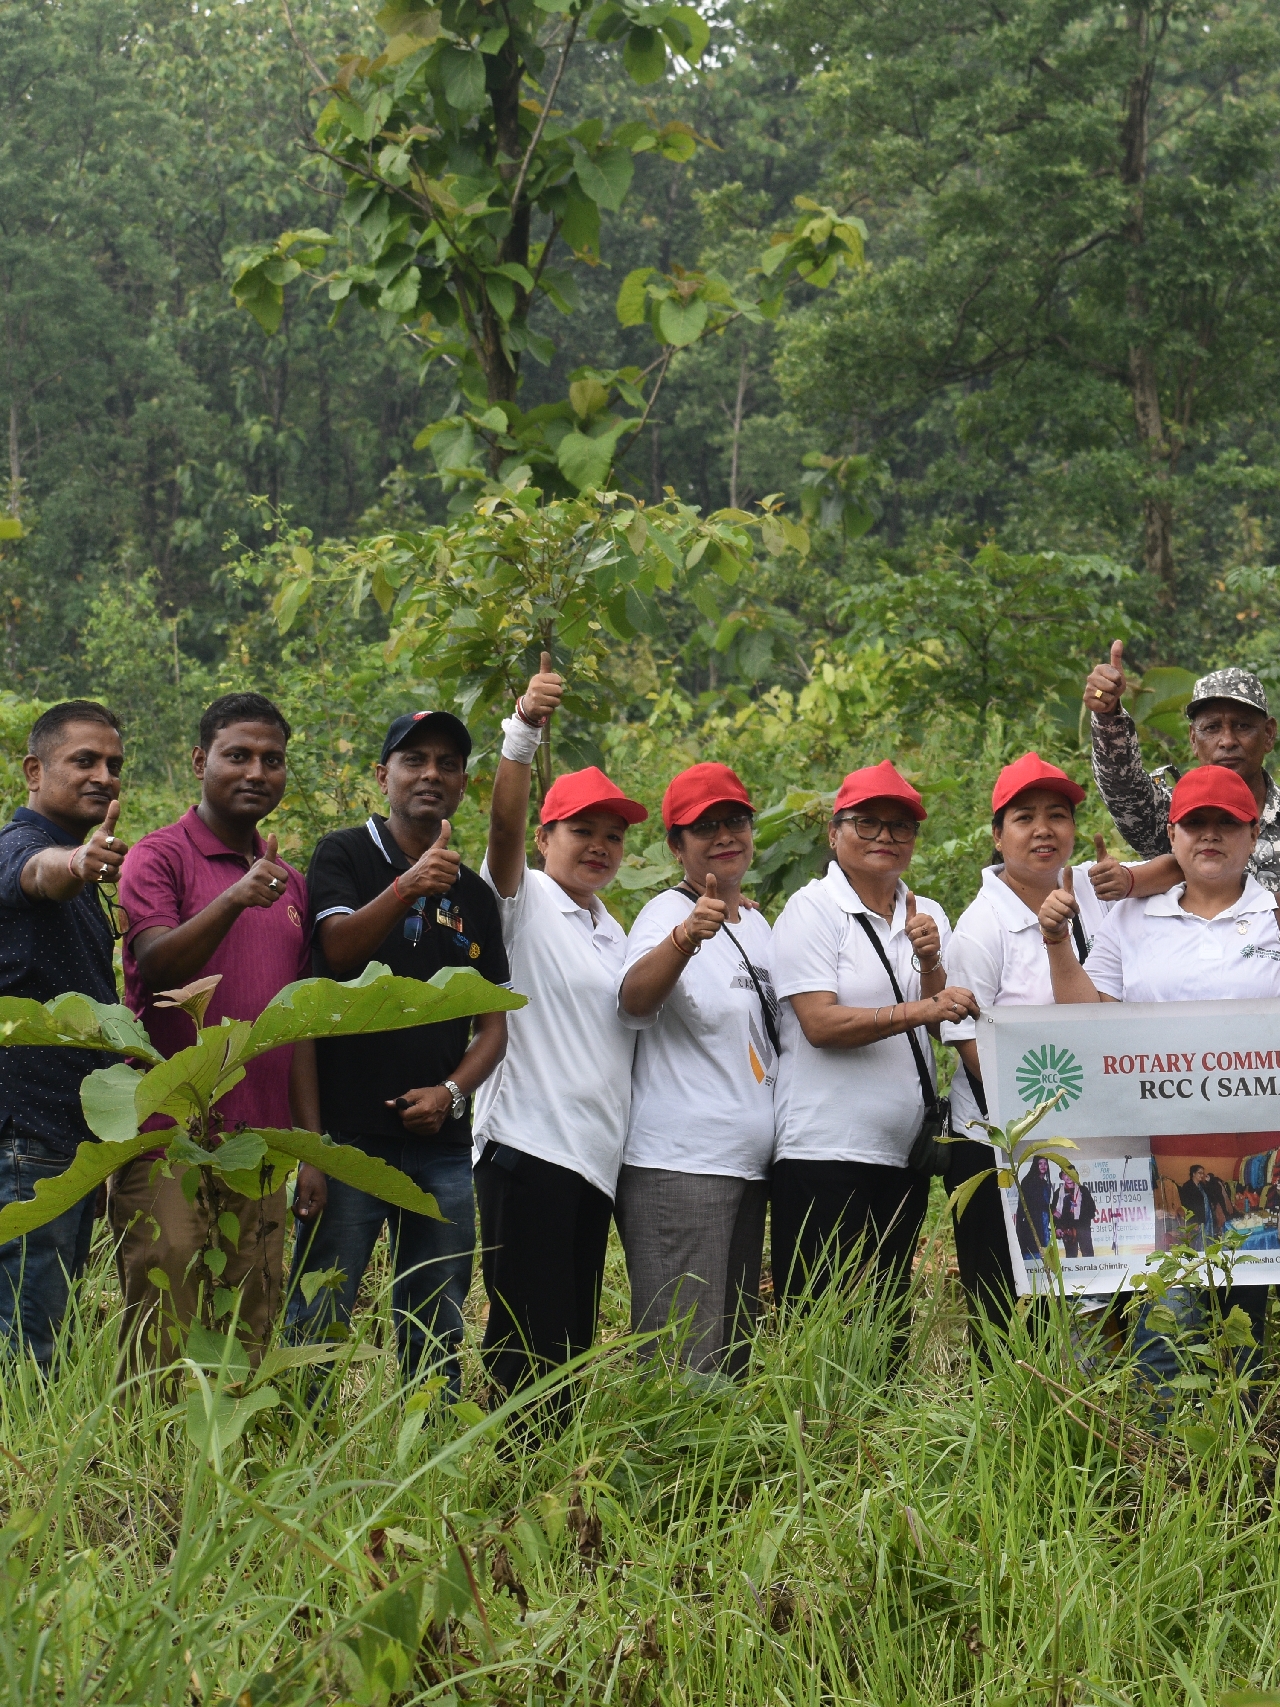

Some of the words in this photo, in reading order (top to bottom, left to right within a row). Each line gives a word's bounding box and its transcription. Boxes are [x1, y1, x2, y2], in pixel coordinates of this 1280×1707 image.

[1103, 1052, 1196, 1074] ROTARY
[1042, 1073, 1058, 1084] RCC
[1139, 1078, 1193, 1100] RCC
